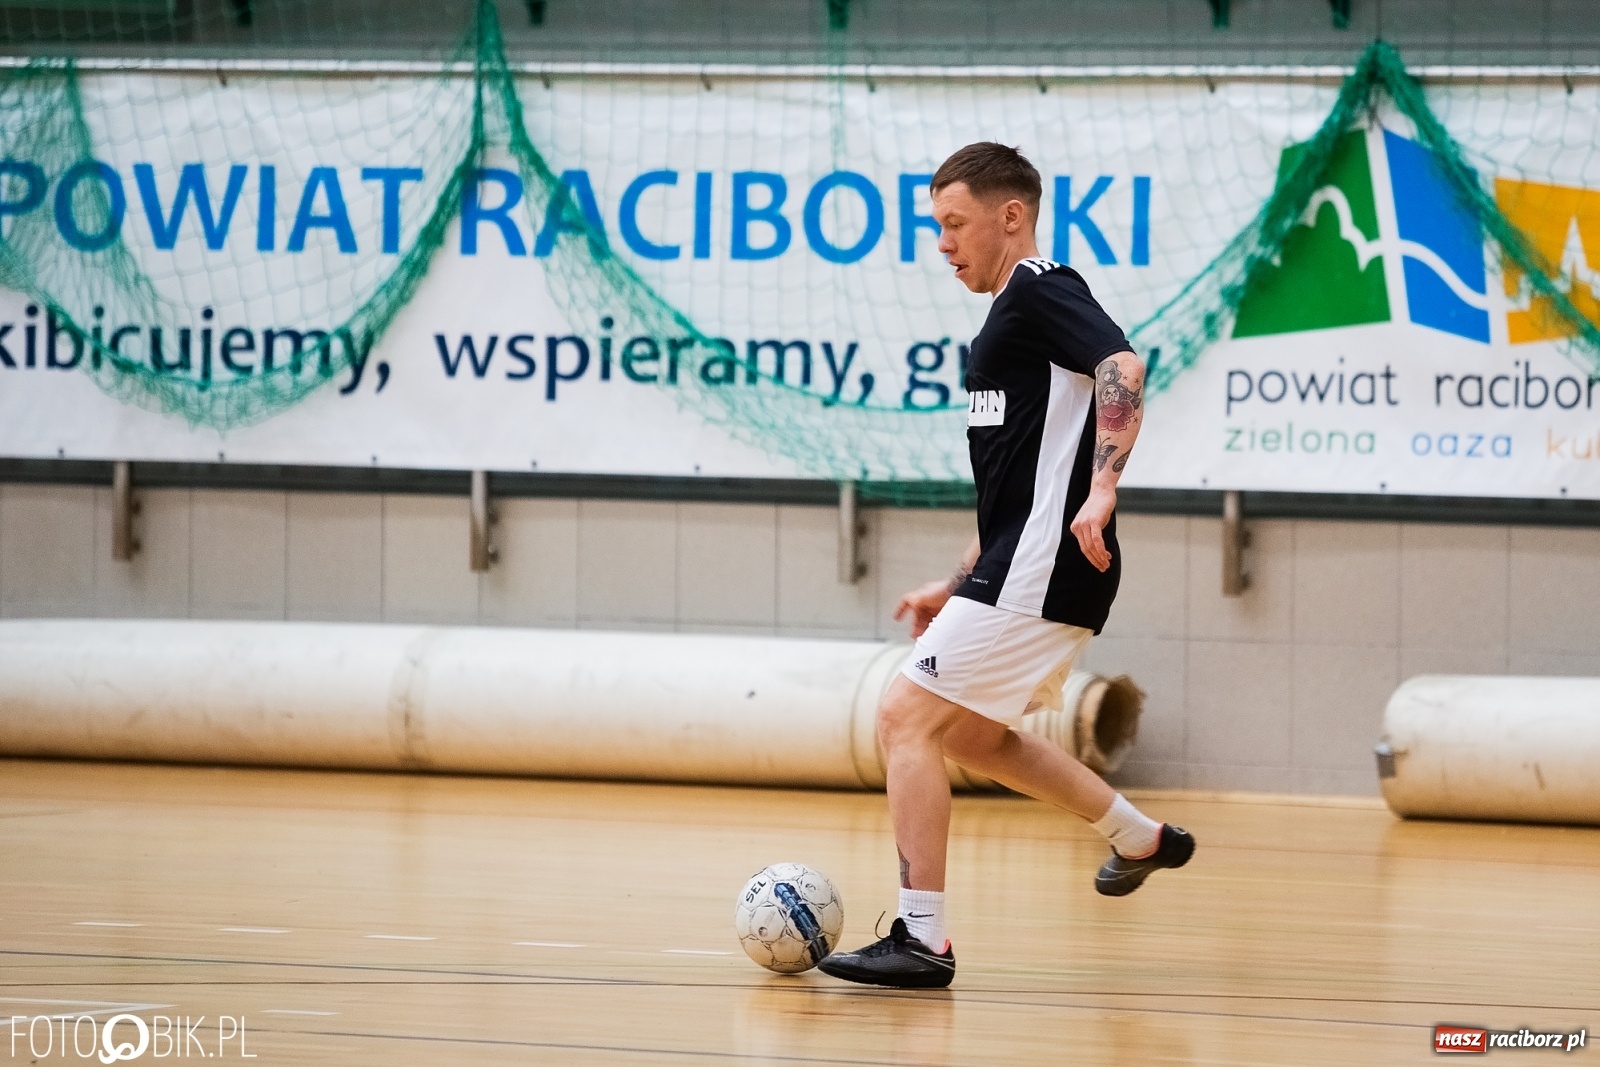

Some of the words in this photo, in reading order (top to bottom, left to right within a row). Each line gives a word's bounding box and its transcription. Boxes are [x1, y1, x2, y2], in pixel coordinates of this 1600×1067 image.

[0, 160, 424, 256] POWIAT
[459, 168, 1153, 266] RACIBORKI
[435, 316, 876, 408] wspieramy,
[1226, 356, 1399, 416] powiat
[1434, 359, 1600, 410] racibor
[1224, 420, 1376, 454] zielona
[1411, 431, 1513, 458] oaza
